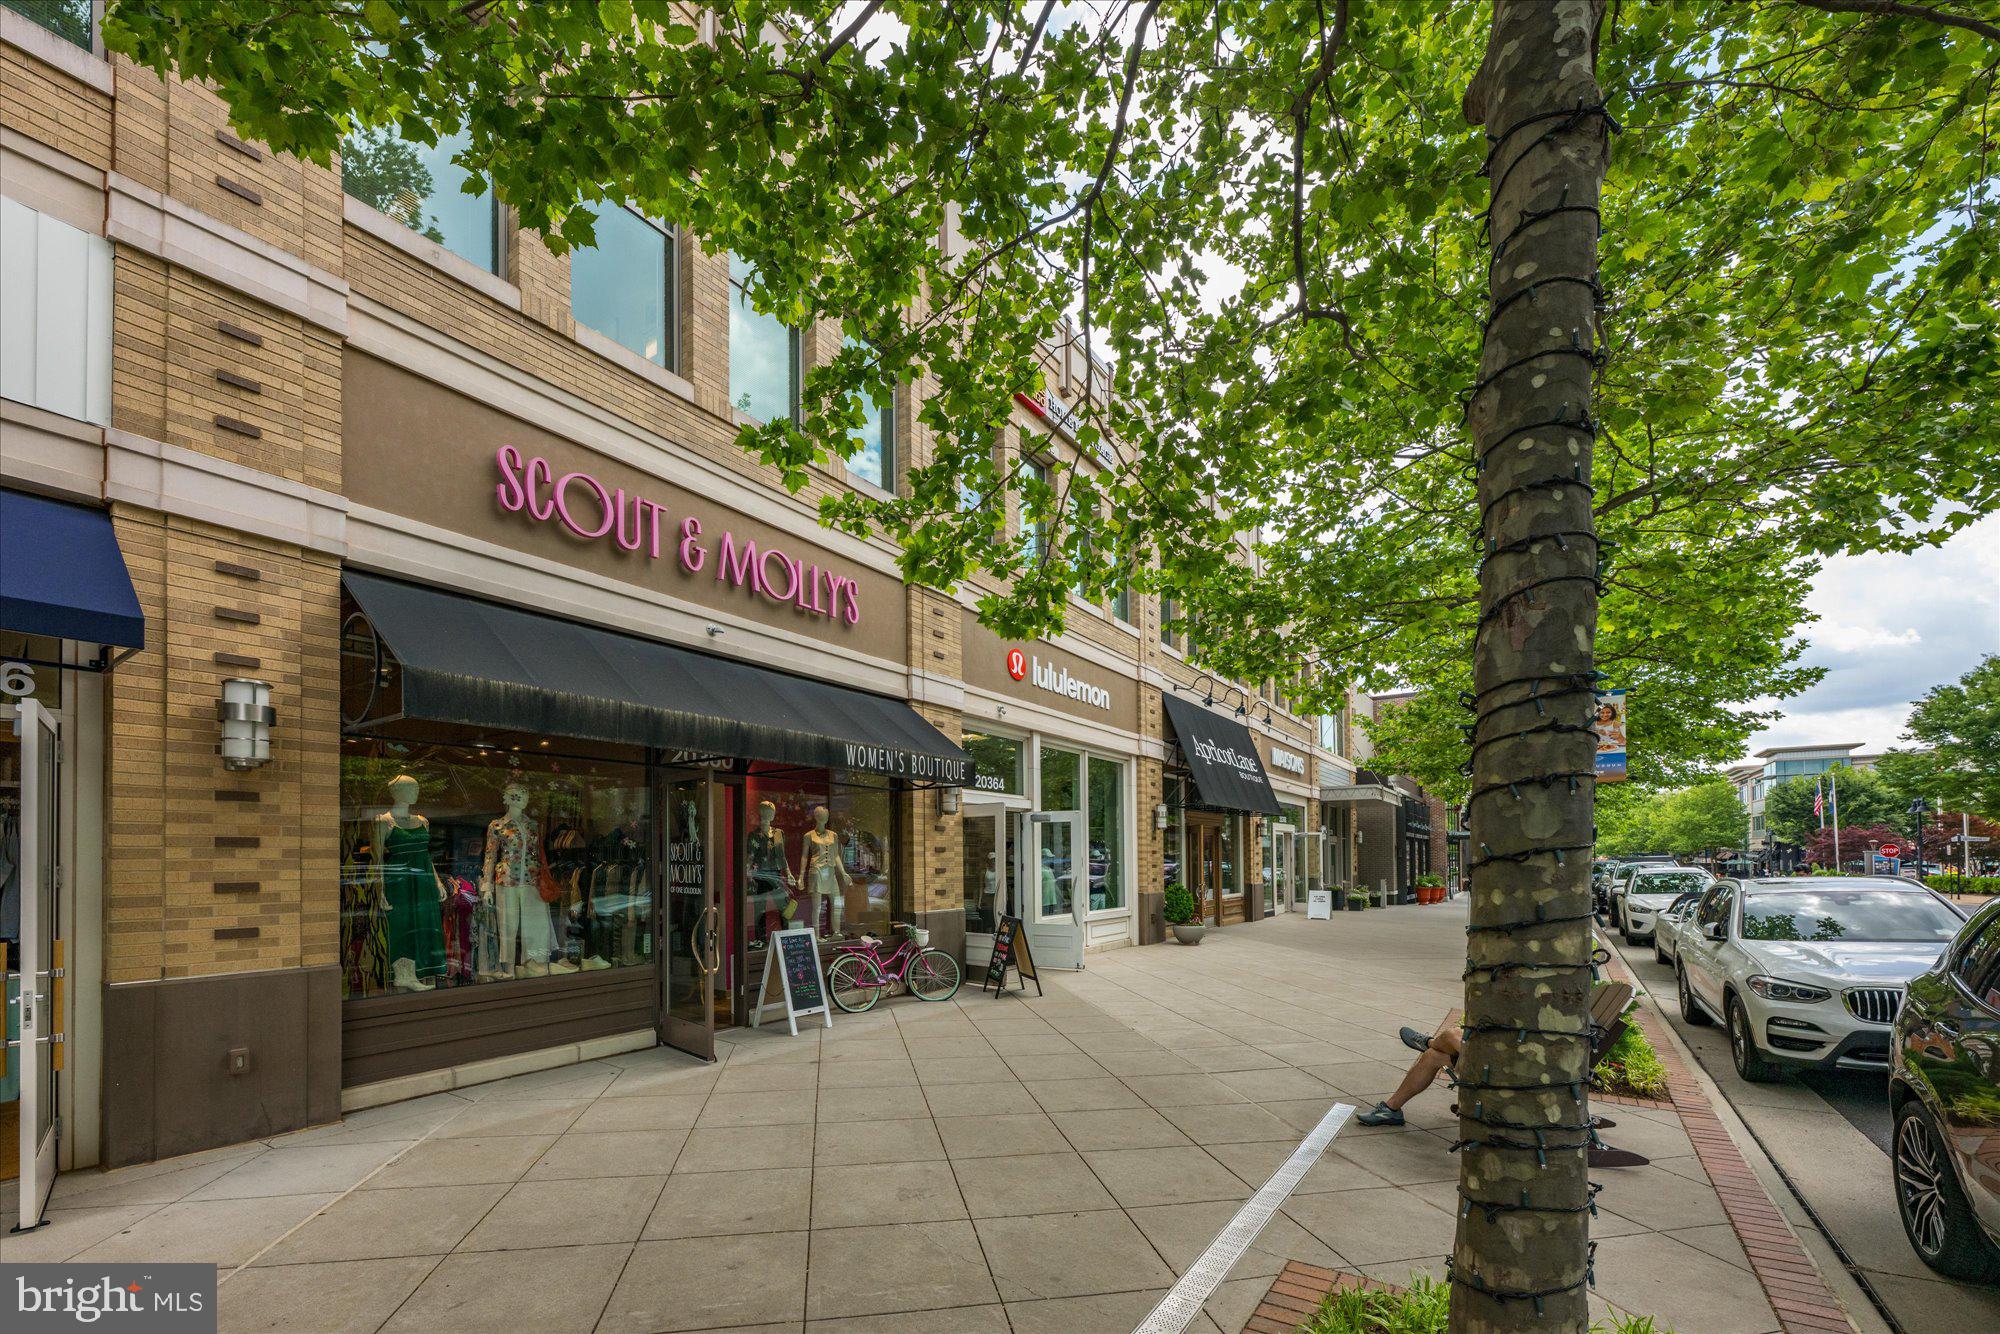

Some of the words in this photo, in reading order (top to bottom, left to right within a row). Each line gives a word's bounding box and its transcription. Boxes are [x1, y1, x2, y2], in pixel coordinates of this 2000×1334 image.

[496, 444, 667, 559] SCOUT
[680, 516, 707, 572] &
[717, 531, 859, 625] MOLLY'S
[1032, 655, 1110, 710] lululemon
[845, 743, 905, 773] WOMEN'S
[911, 754, 966, 781] BOUTIQUE
[974, 774, 1005, 791] 20364
[1238, 771, 1264, 784] BOUTIQUE
[670, 842, 693, 861] SCOUT
